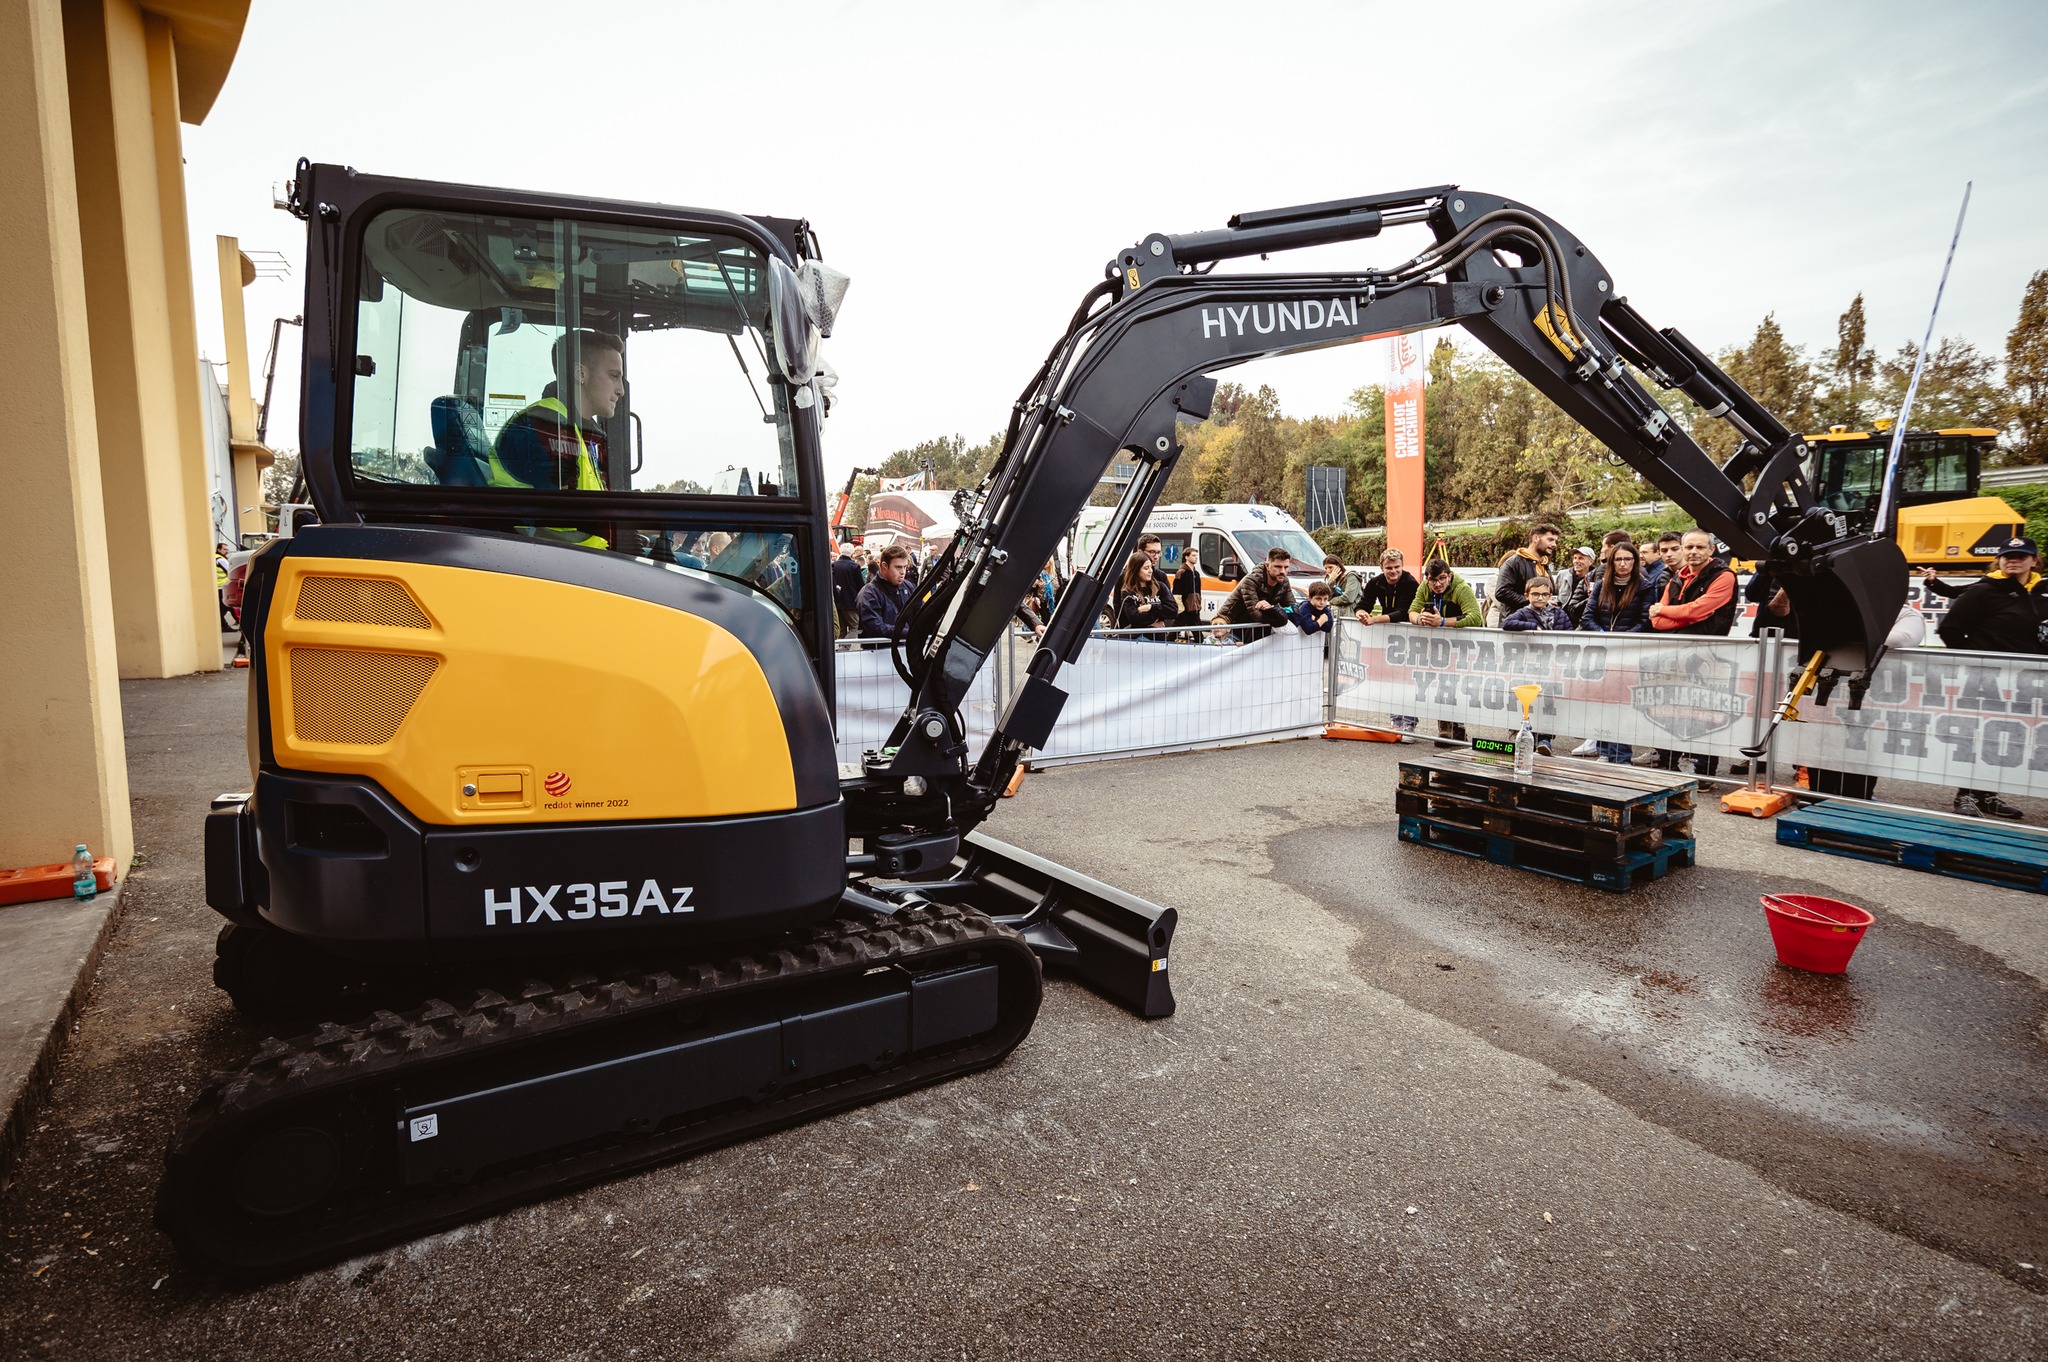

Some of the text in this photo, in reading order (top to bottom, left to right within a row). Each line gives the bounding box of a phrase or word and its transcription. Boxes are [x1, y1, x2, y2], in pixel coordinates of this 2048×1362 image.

[1201, 297, 1359, 339] HYUNDAI
[1149, 513, 1179, 521] BULANZA
[575, 800, 604, 808] winner
[607, 799, 629, 807] 2022
